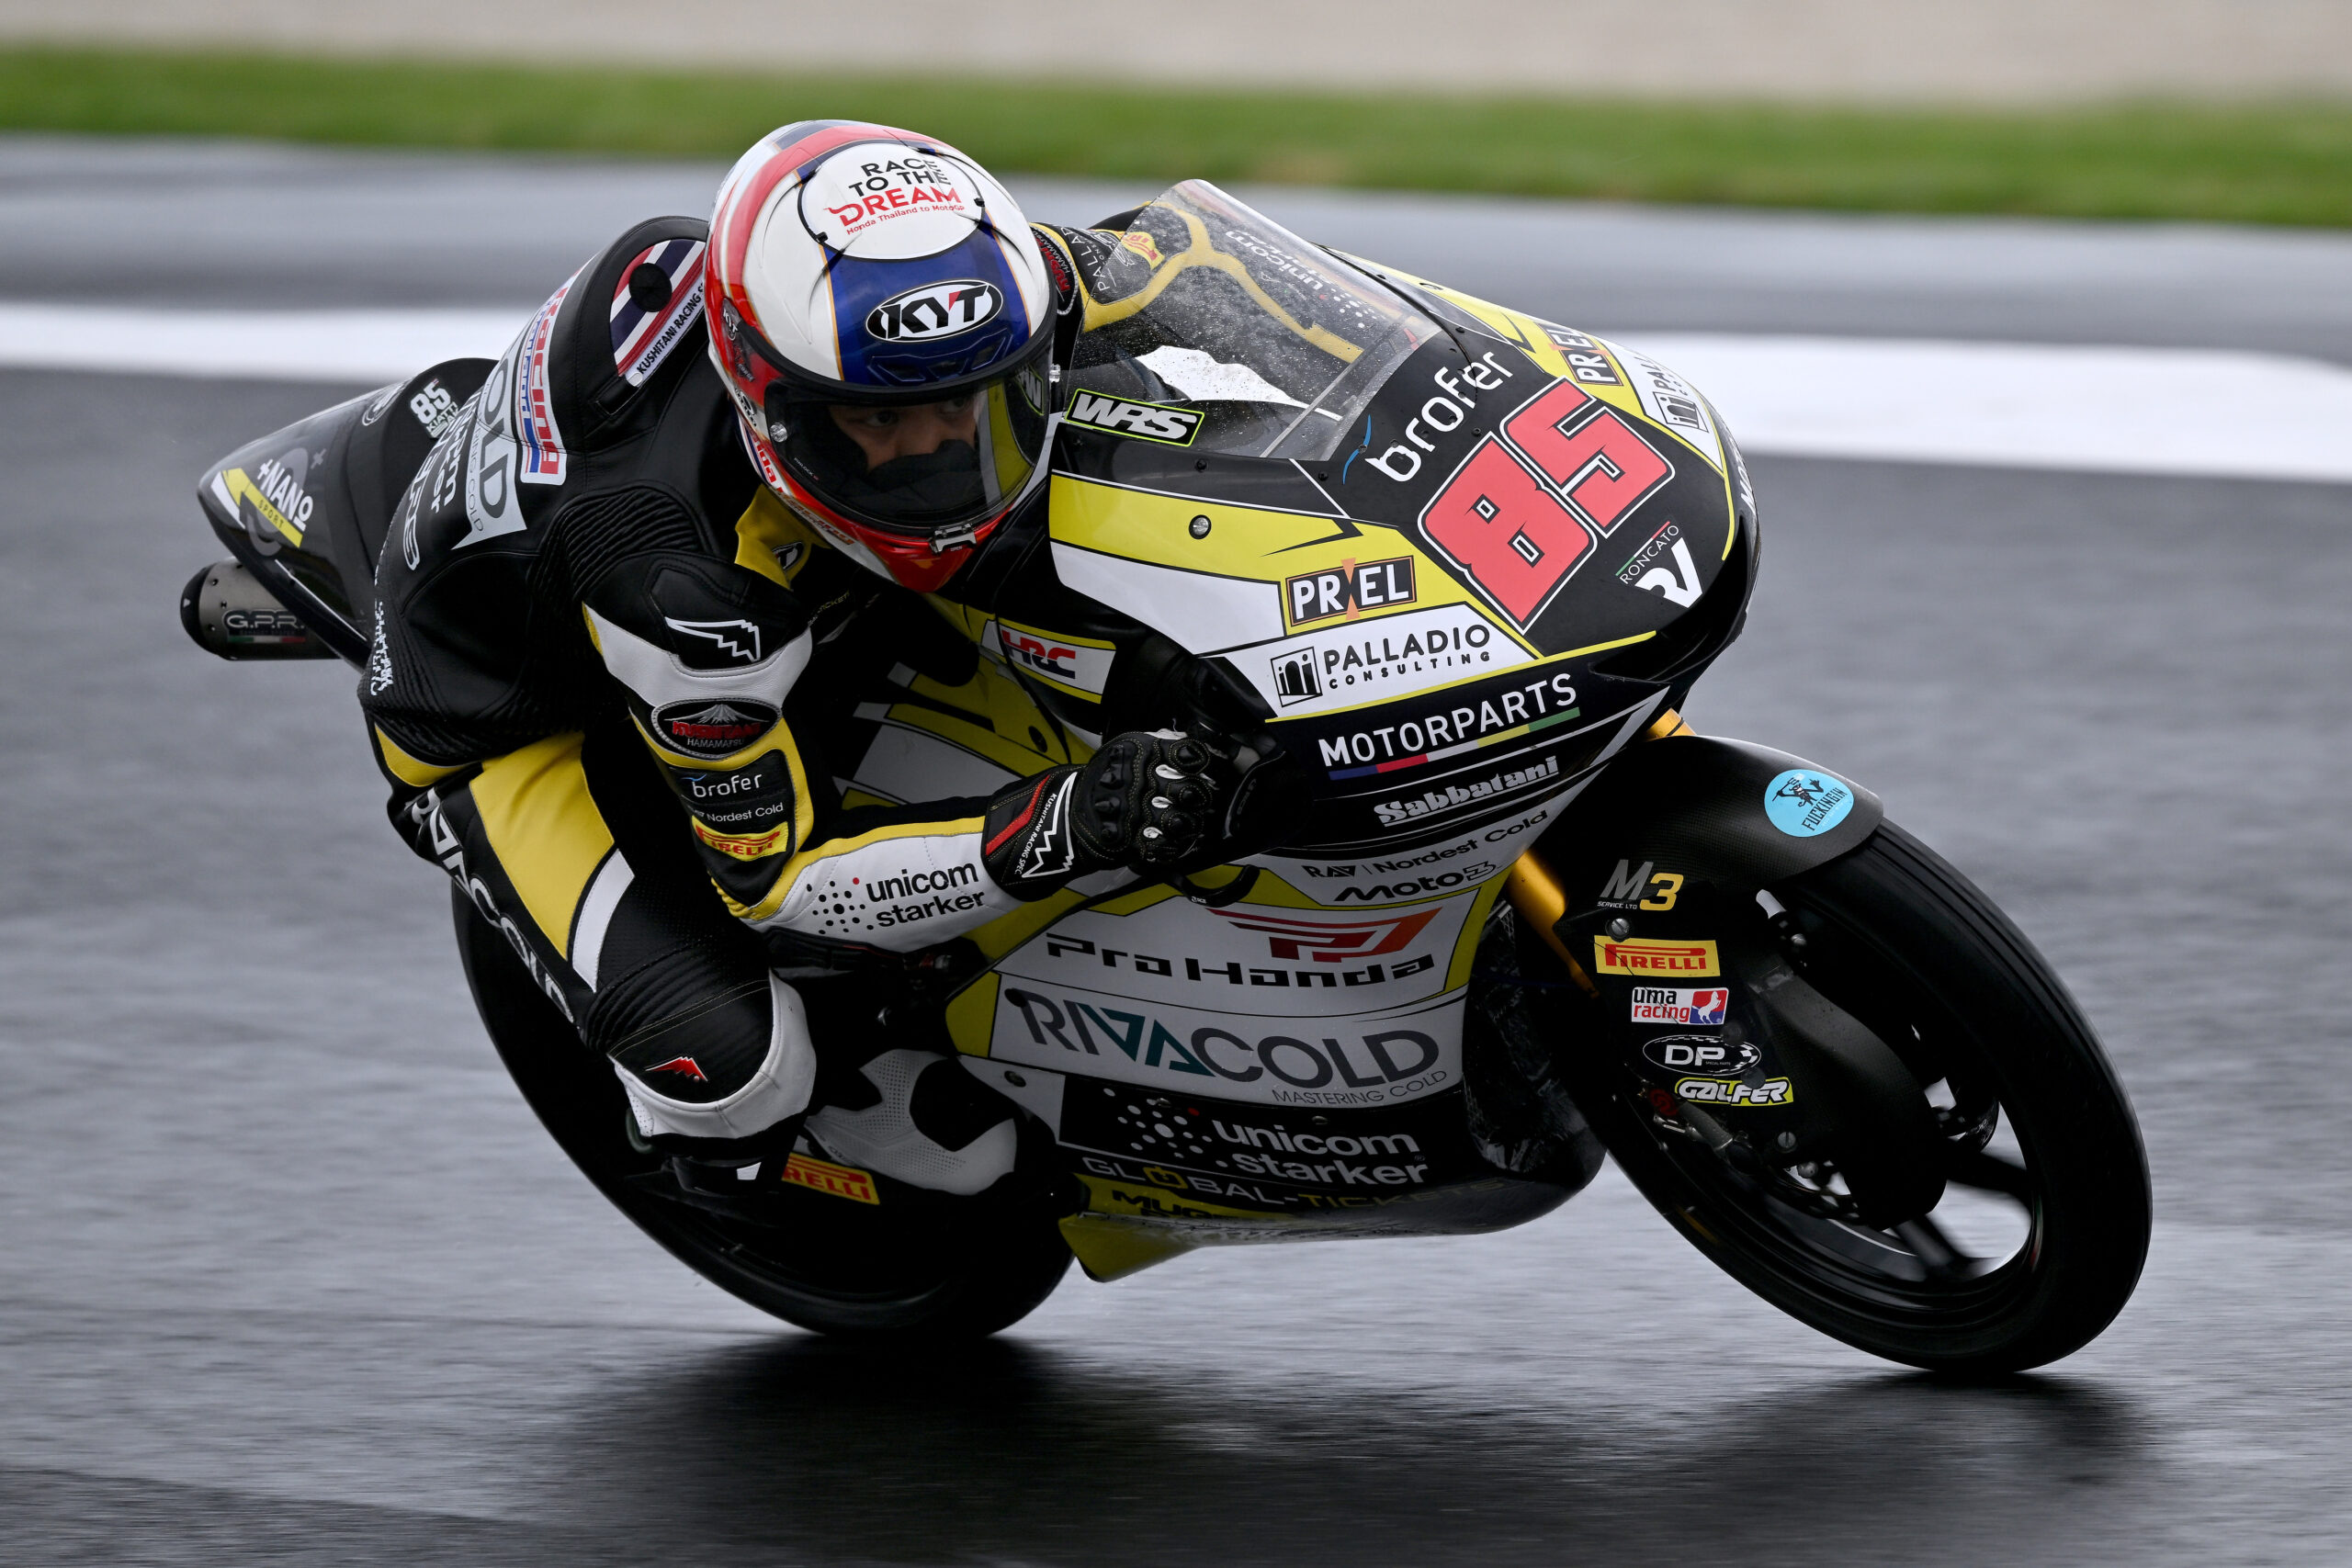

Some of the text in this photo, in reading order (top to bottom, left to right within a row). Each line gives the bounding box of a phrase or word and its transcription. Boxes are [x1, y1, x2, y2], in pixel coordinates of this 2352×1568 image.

[848, 170, 952, 197] TO THE
[823, 186, 962, 227] DREAM
[846, 219, 876, 235] Honda
[877, 207, 918, 222] Thailand
[880, 284, 989, 340] KYT
[636, 325, 678, 374] KUSHITANI
[673, 293, 702, 329] RACING
[410, 378, 451, 424] 85
[1070, 395, 1197, 439] WRS
[1365, 351, 1513, 482] brofer
[256, 499, 285, 529] SPORT
[1417, 375, 1676, 635] 85
[1619, 525, 1679, 584] RONCATO
[1001, 629, 1076, 680] HRC
[1323, 624, 1490, 675] PALLADIO
[1329, 650, 1490, 691] CONSULTING
[1317, 672, 1577, 767] MOTORPARTS
[687, 738, 744, 749] HAMAMATSU
[692, 773, 763, 798] brofer
[1374, 755, 1560, 825] Sabbatani
[707, 809, 752, 822] Nordest
[755, 802, 784, 818] Cold
[1035, 793, 1058, 832] KUSHITANI
[695, 825, 781, 856] PIRELLI
[1021, 831, 1038, 859] RACING
[1373, 838, 1479, 874] Nordest
[1484, 810, 1549, 843] Cold
[865, 862, 979, 903] unicom
[1334, 860, 1498, 902] Moto3
[1600, 859, 1684, 911] M3
[876, 888, 986, 929] starker
[1597, 900, 1623, 909] SERVICE
[1604, 942, 1707, 970] PIRELLI
[1633, 988, 1678, 1005] uma
[1633, 1003, 1690, 1023] racing
[1003, 987, 1440, 1089] RIVACOLD
[1664, 1044, 1725, 1066] DP
[1272, 1070, 1448, 1104] MASTERING COLD
[1679, 1080, 1788, 1103] GALFER
[1210, 1118, 1420, 1156] unicom
[782, 1155, 871, 1201] RELLI
[1233, 1151, 1430, 1185] starker
